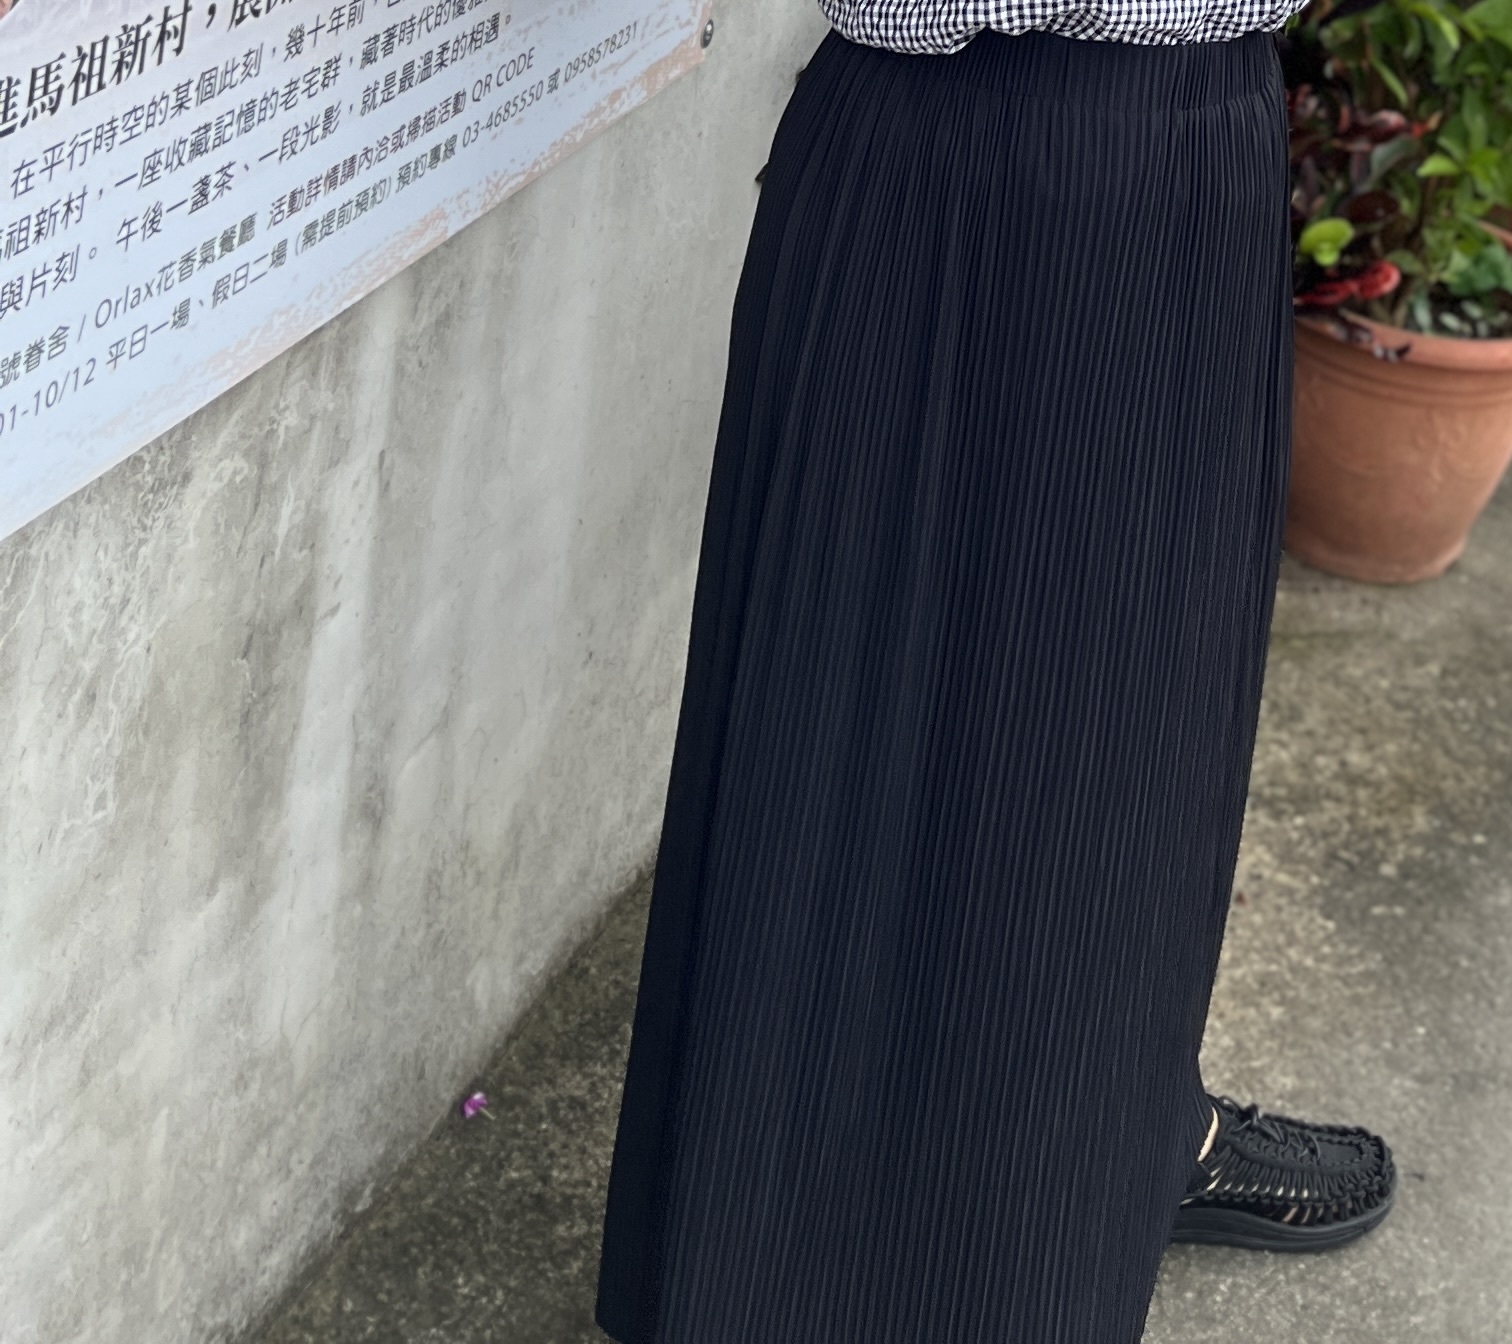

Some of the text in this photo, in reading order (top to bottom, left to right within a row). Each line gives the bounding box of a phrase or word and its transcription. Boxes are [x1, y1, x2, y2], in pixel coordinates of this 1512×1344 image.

[462, 79, 544, 148] 03-4685550
[547, 67, 561, 95] 或
[564, 19, 638, 84] 0958578231
[471, 79, 492, 102] QR
[496, 46, 536, 88] CODE
